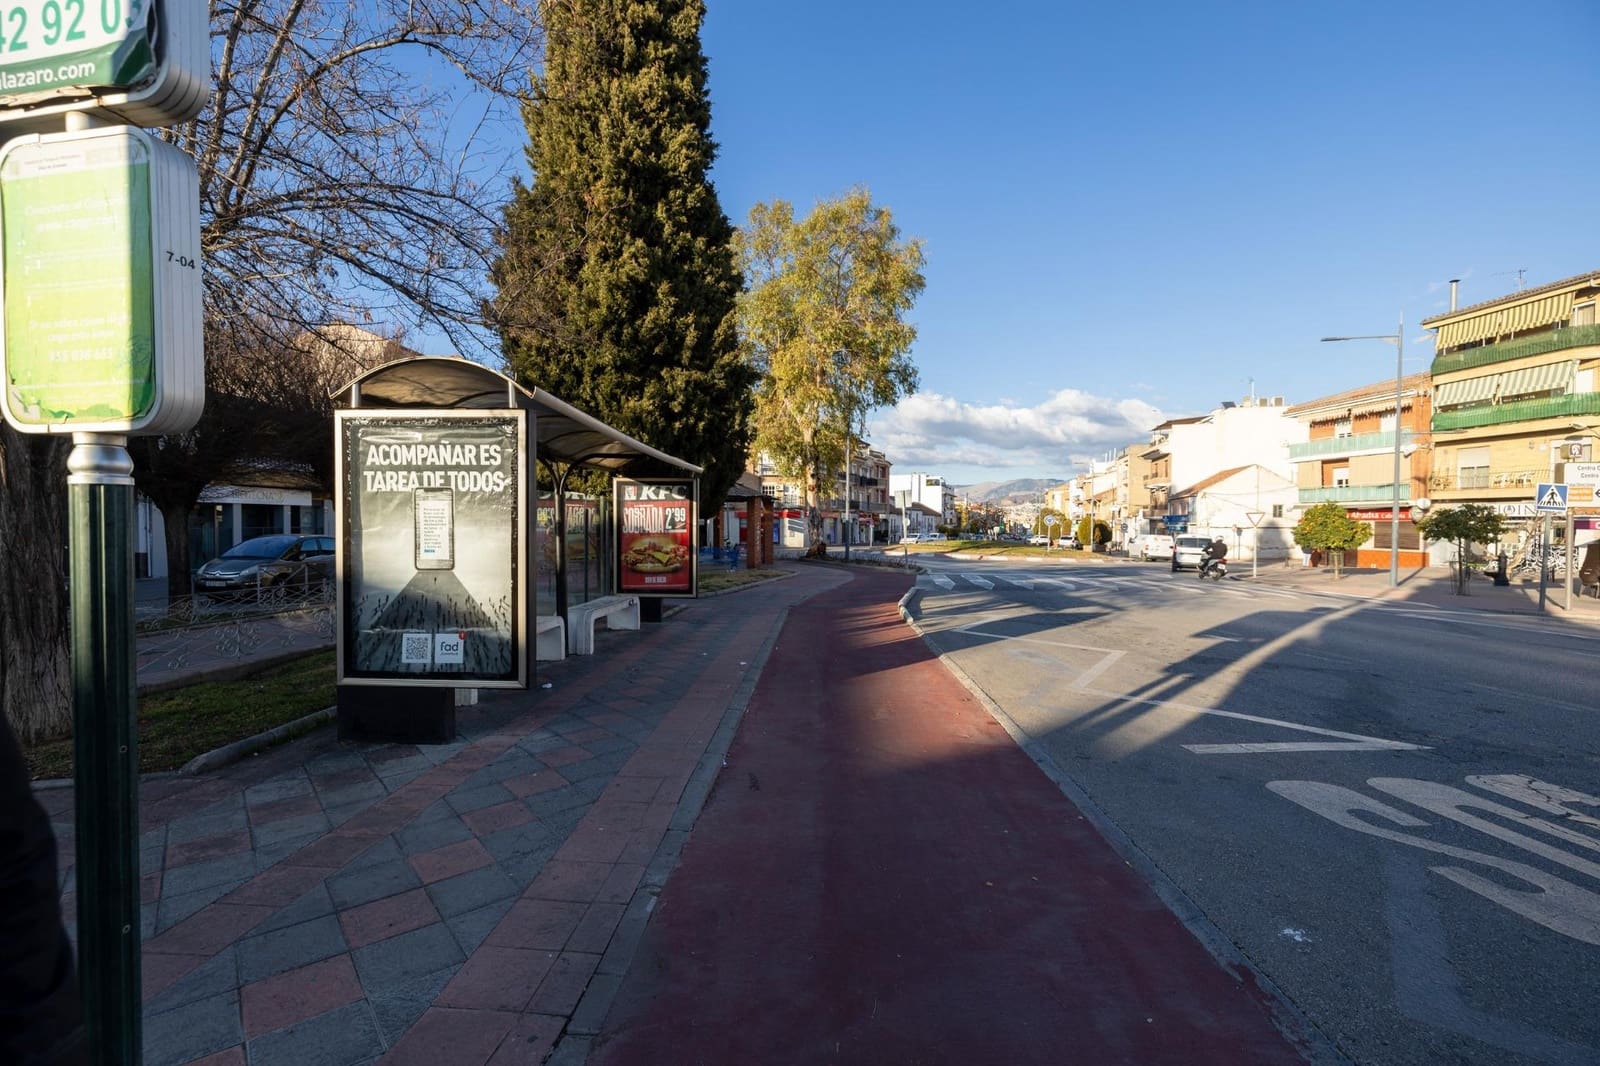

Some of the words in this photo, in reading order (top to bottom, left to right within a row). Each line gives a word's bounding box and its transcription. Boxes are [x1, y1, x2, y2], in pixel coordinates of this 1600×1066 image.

[42, 0, 86, 46] 92
[0, 62, 96, 90] lazaro.com
[166, 250, 195, 270] 7-04
[366, 440, 476, 466] ACOMPAÑAR
[480, 444, 502, 465] ES
[363, 471, 419, 492] TAREA
[423, 471, 448, 489] DE
[448, 471, 504, 492] TODOS
[640, 485, 687, 500] KFC
[440, 641, 459, 652] fad
